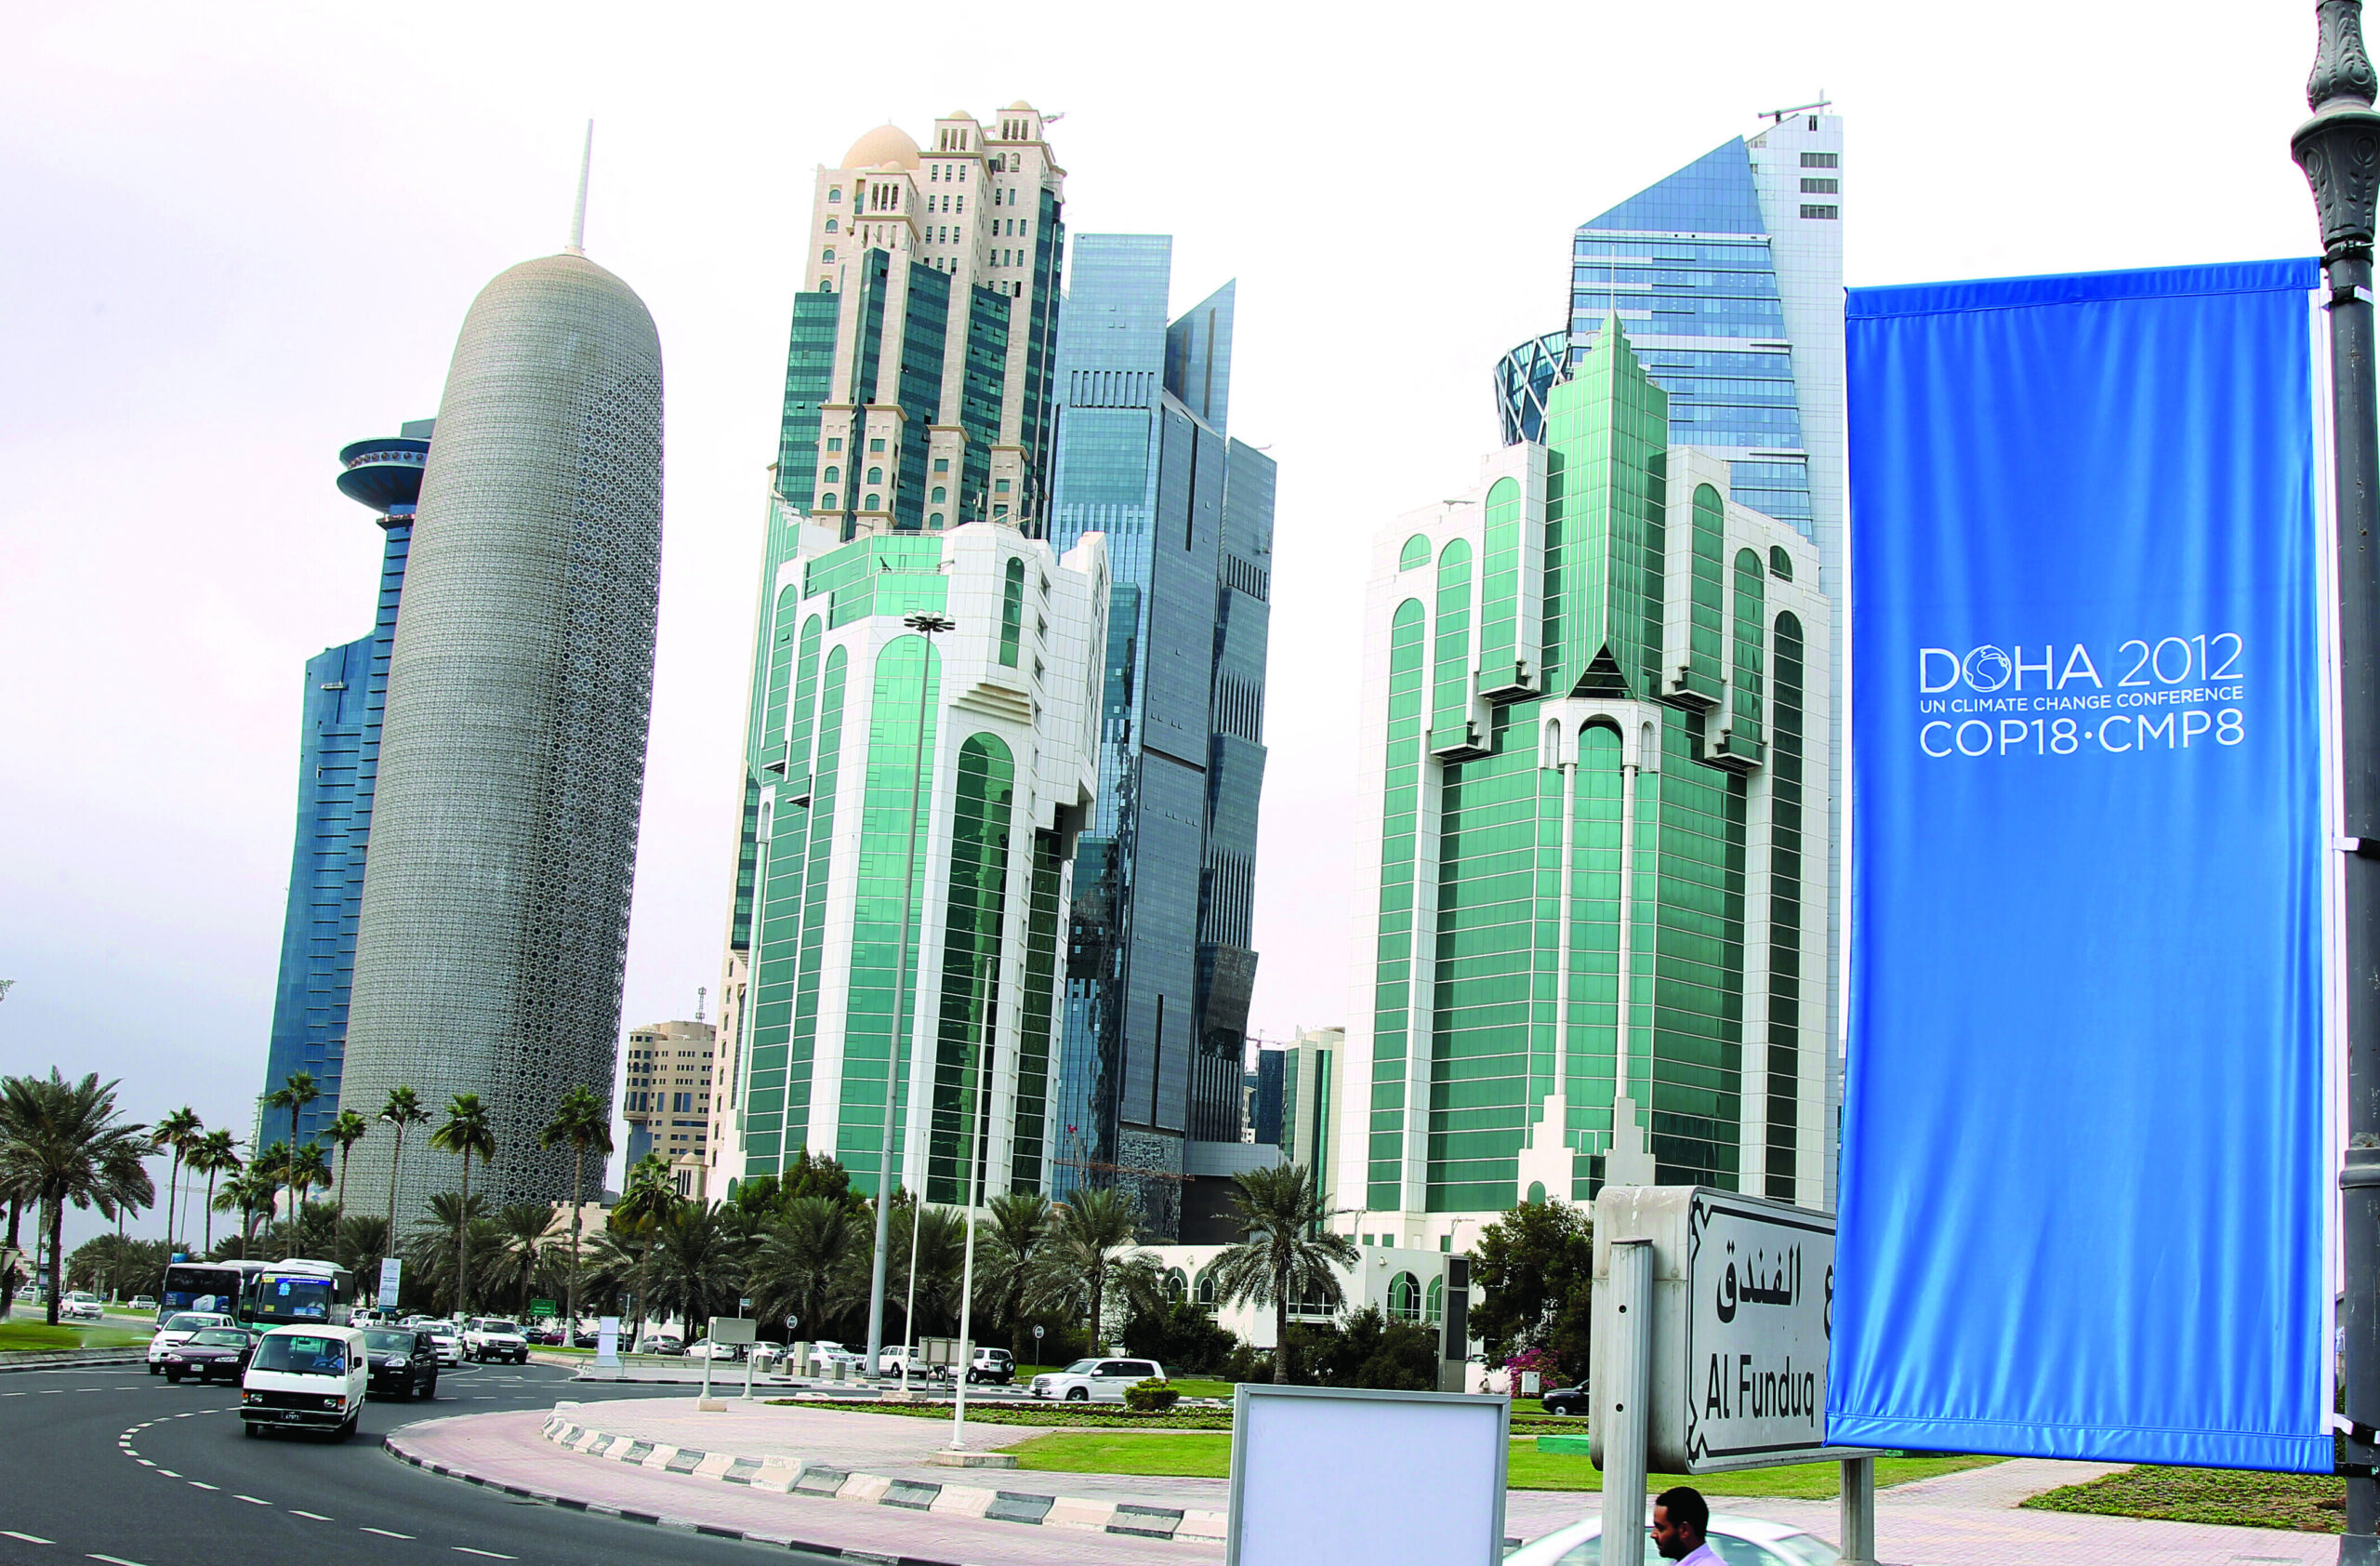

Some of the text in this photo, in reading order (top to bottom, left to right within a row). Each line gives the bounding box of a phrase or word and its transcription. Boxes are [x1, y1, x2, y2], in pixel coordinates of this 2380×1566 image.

[1920, 632, 2245, 694] DOHA 2012
[1920, 684, 2244, 714] UN CLIMATE CHANGE CONFERENCE
[1716, 1240, 1802, 1324] الفندق
[1705, 1353, 1731, 1420] Al
[1739, 1354, 1816, 1428] Funduq
